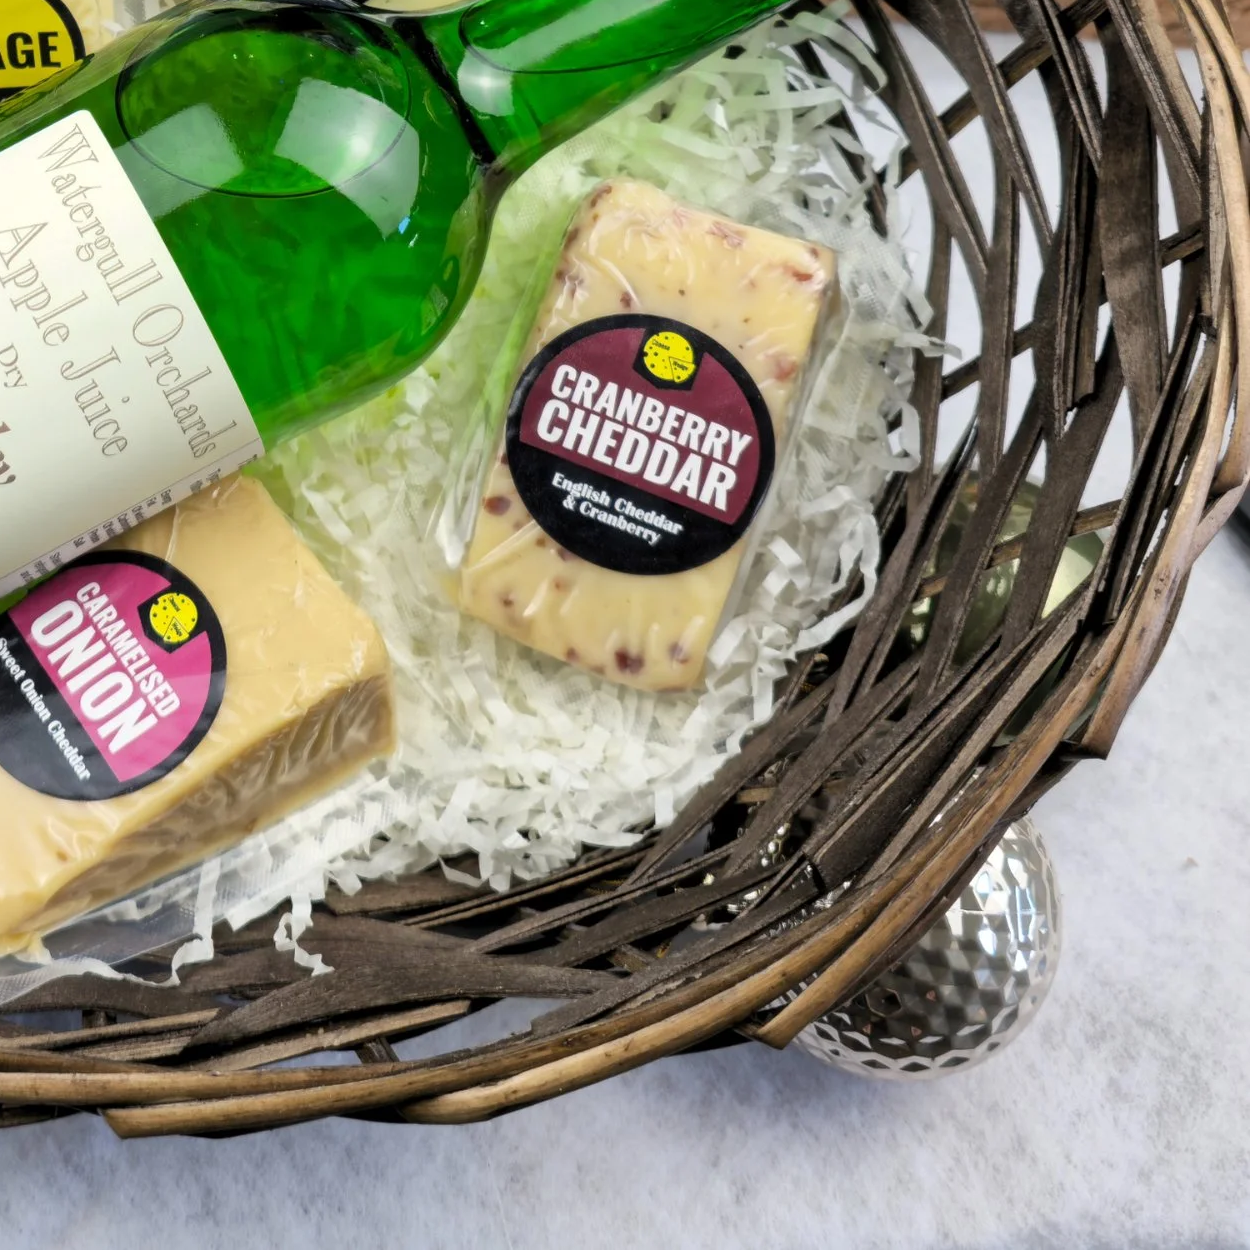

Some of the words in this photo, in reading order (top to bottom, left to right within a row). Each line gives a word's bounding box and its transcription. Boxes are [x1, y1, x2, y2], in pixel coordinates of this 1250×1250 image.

[37, 123, 164, 306] Watergull
[131, 302, 238, 459] Orchards
[60, 346, 131, 457] Juice
[536, 399, 737, 512] CHEDDAR
[551, 364, 753, 467] CRANBERRY
[551, 471, 611, 506] English
[613, 497, 685, 535] Cheddar
[562, 496, 576, 511] &
[579, 499, 663, 546] Cranberry
[31, 599, 159, 755] ONION
[76, 581, 181, 719] CARAMELISED
[20, 678, 51, 723] Onion
[47, 718, 91, 781] Cheddar
